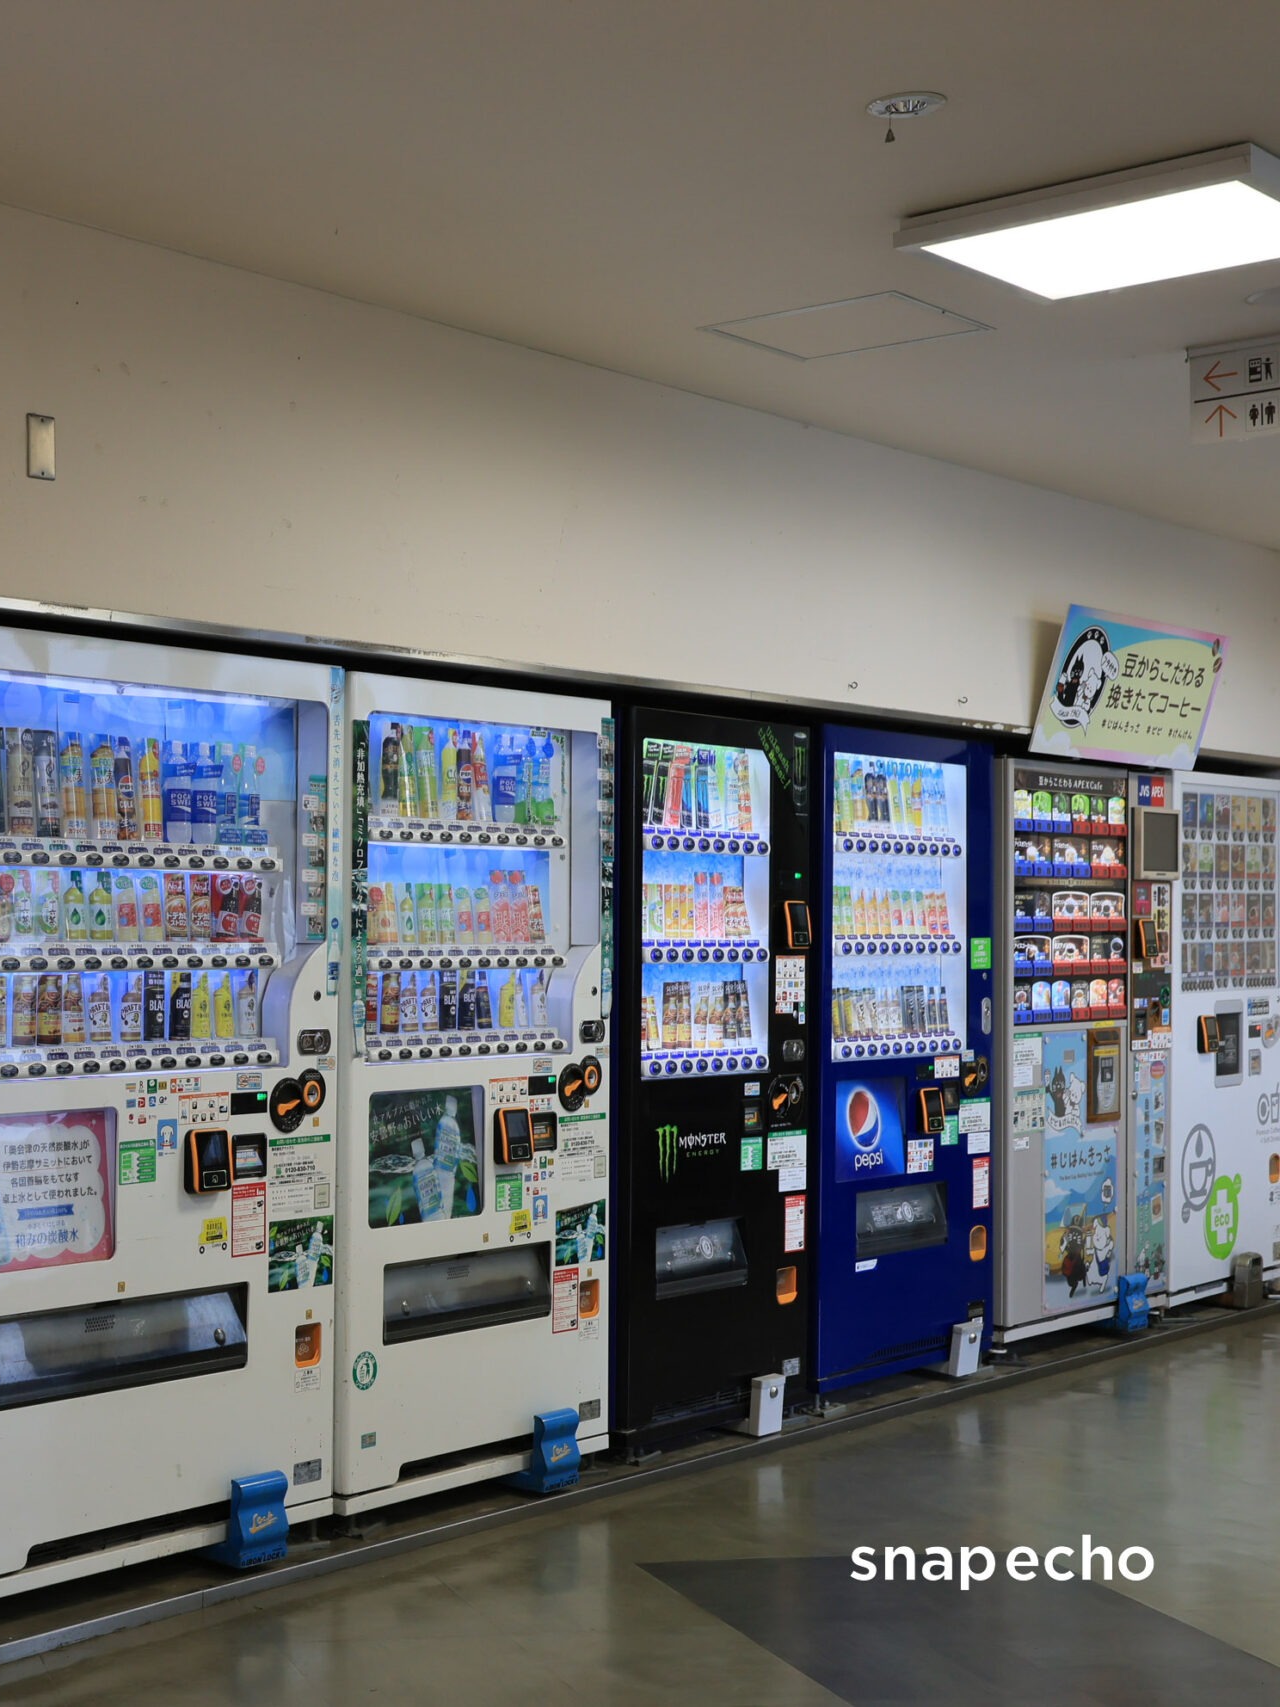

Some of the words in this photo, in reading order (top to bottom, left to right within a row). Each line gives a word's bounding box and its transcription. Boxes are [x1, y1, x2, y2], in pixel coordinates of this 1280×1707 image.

[1121, 653, 1205, 689] 豆からこだわる
[1105, 684, 1202, 718] 挽きたてコーヒー
[1038, 776, 1073, 788] 豆からこだわる
[1074, 779, 1090, 789] APEX
[1090, 780, 1104, 791] Cafe
[1139, 786, 1150, 797] JVS
[1151, 785, 1164, 798] APEX
[678, 1131, 727, 1149] MONSTER
[686, 1149, 720, 1158] ENERGY
[854, 1149, 884, 1171] pepsi
[1051, 1145, 1111, 1169] #じはんきっさ
[2, 1155, 92, 1171] 伊勢志摩サミットにおいて
[285, 1165, 316, 1173] 0120-830-710
[11, 1172, 79, 1188] 各国首脳をもてなす
[1214, 1214, 1230, 1226] eco
[15, 1229, 79, 1248] 和みの炭酸水
[249, 1511, 278, 1534] Lock
